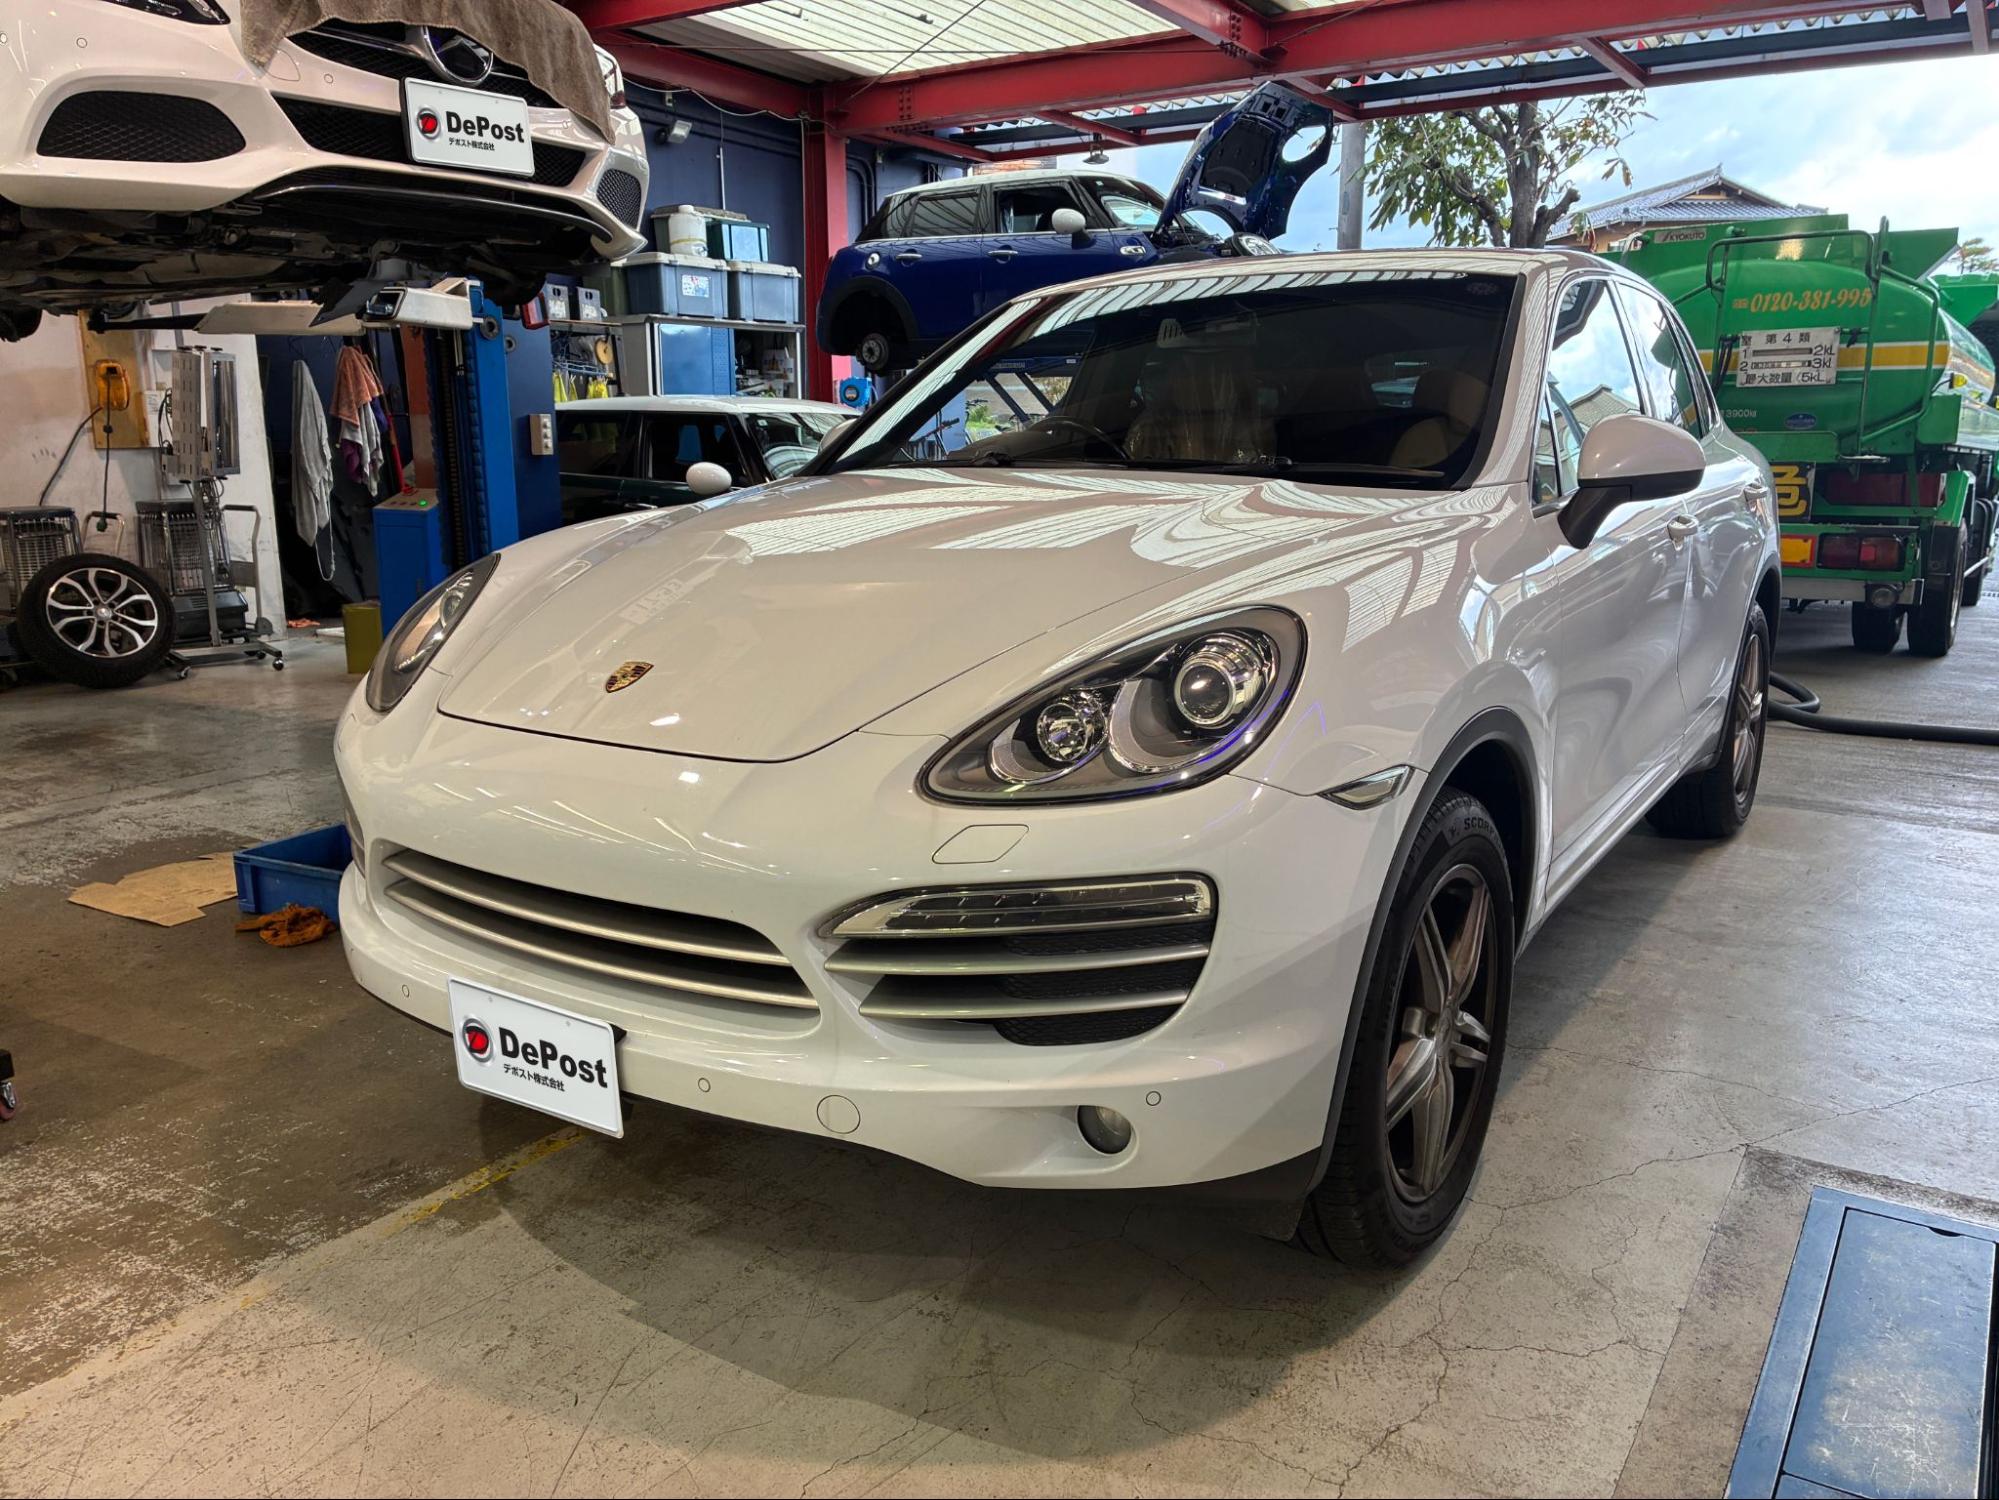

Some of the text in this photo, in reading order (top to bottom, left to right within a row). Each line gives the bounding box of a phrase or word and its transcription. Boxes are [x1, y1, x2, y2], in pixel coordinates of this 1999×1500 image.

[446, 110, 525, 143] DePost
[448, 137, 495, 151] デポスト株式会社
[1669, 231, 1705, 241] KYOKUTO
[1750, 288, 1872, 313] 0120-381-995
[1740, 362, 1748, 372] 2
[498, 1027, 608, 1089] DePost
[503, 1063, 566, 1092] デポスト株式会社
